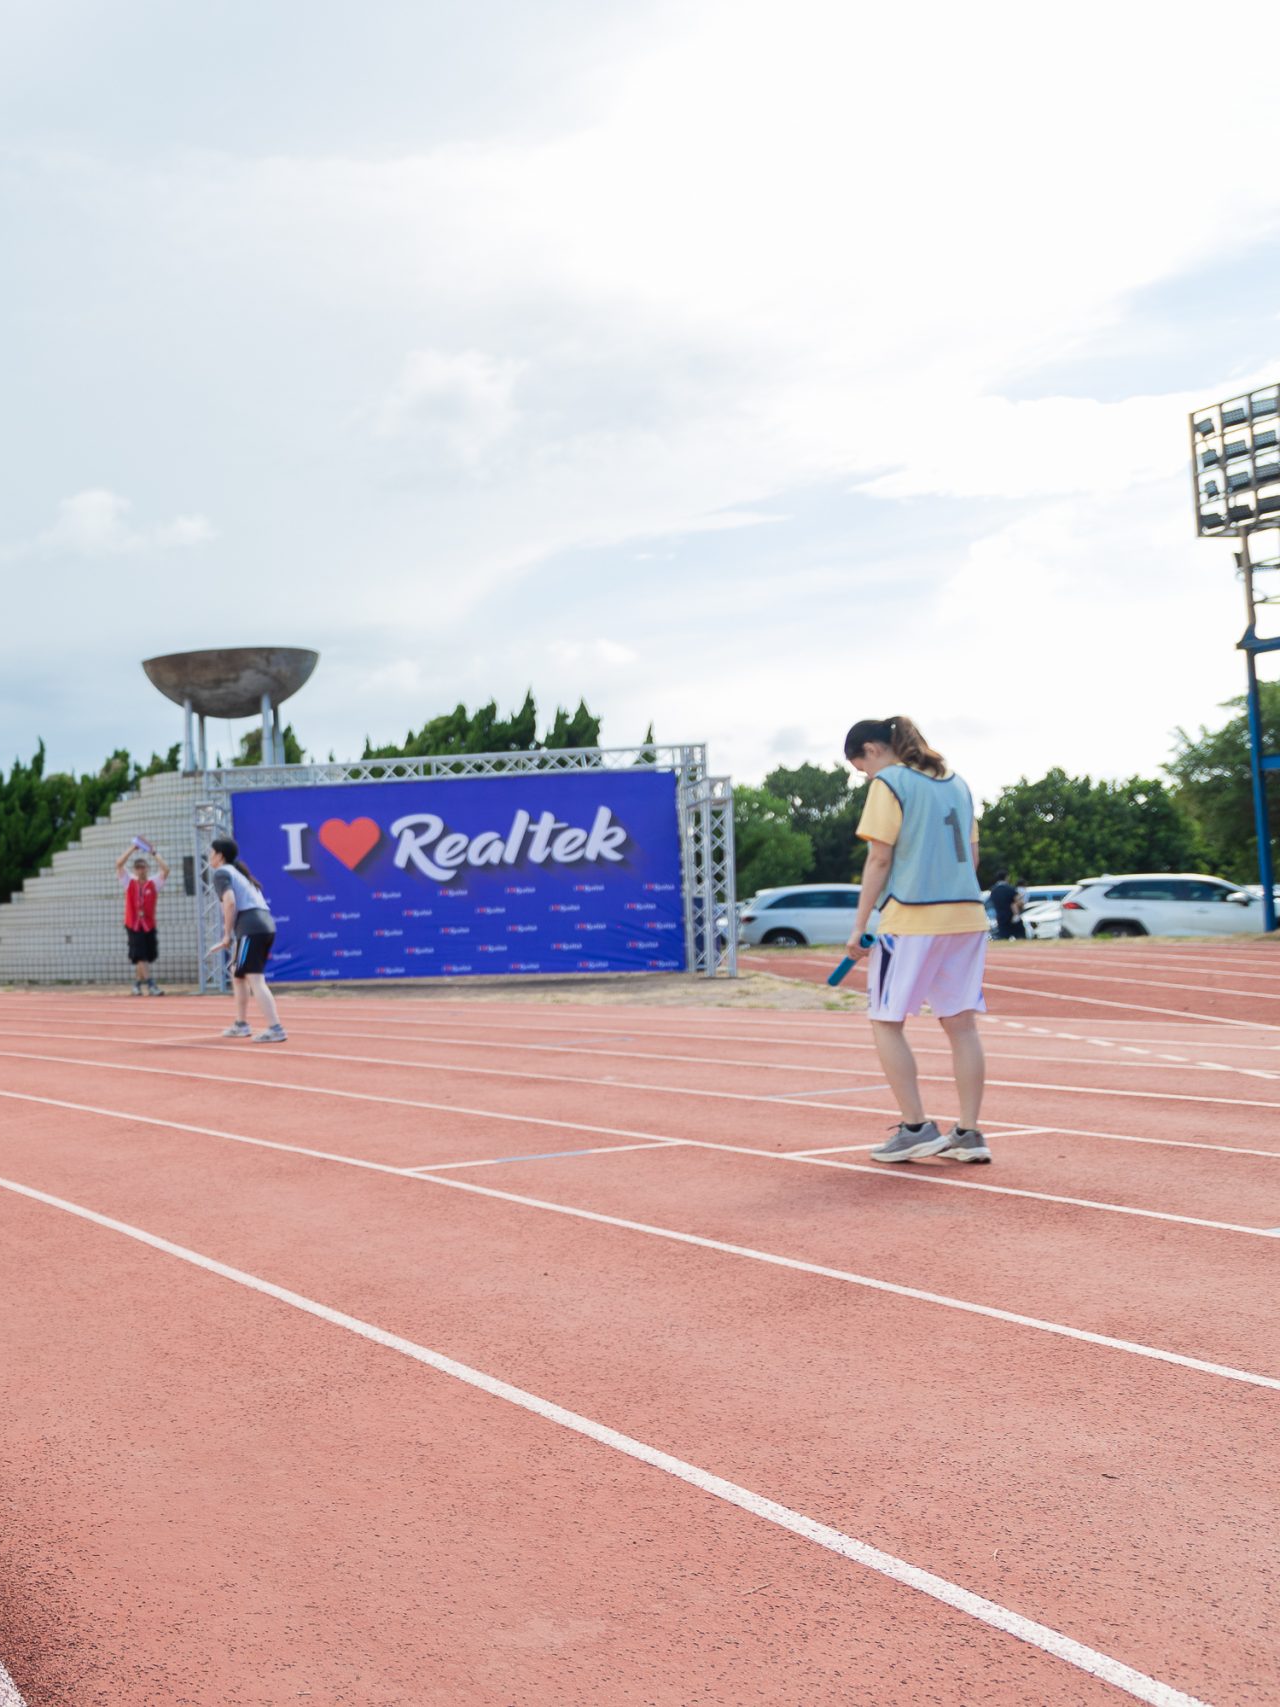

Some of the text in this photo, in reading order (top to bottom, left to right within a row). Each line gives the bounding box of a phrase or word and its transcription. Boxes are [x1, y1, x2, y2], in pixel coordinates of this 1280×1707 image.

[280, 805, 627, 881] I Realtek
[944, 807, 967, 863] 1
